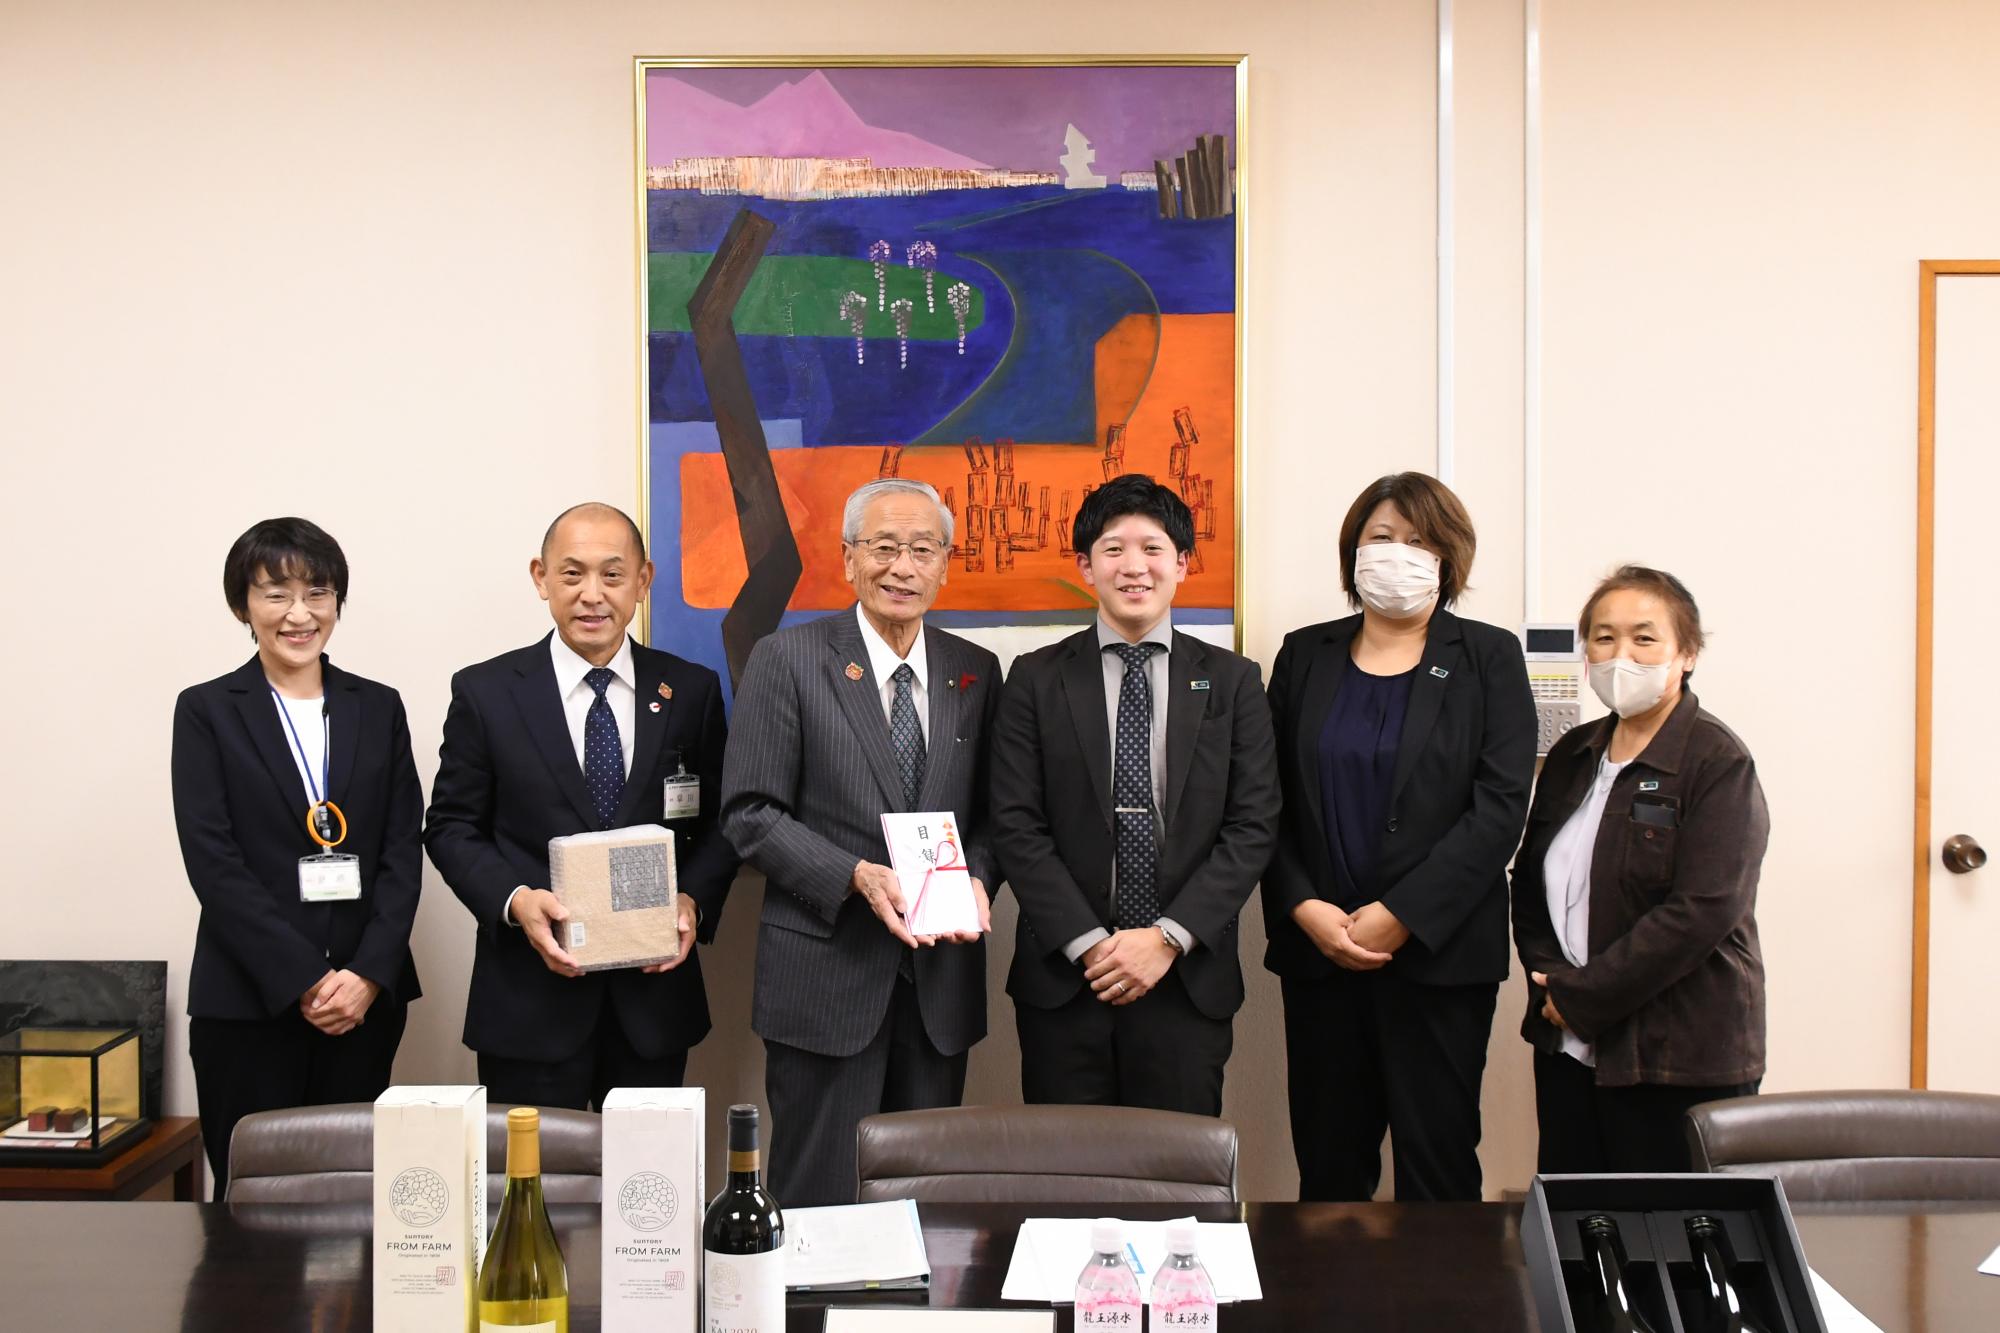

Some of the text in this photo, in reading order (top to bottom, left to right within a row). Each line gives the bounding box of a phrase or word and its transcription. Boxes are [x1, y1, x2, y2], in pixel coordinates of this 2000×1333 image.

[387, 1242, 452, 1251] FROM FARM
[615, 1247, 681, 1255] FROM FARM
